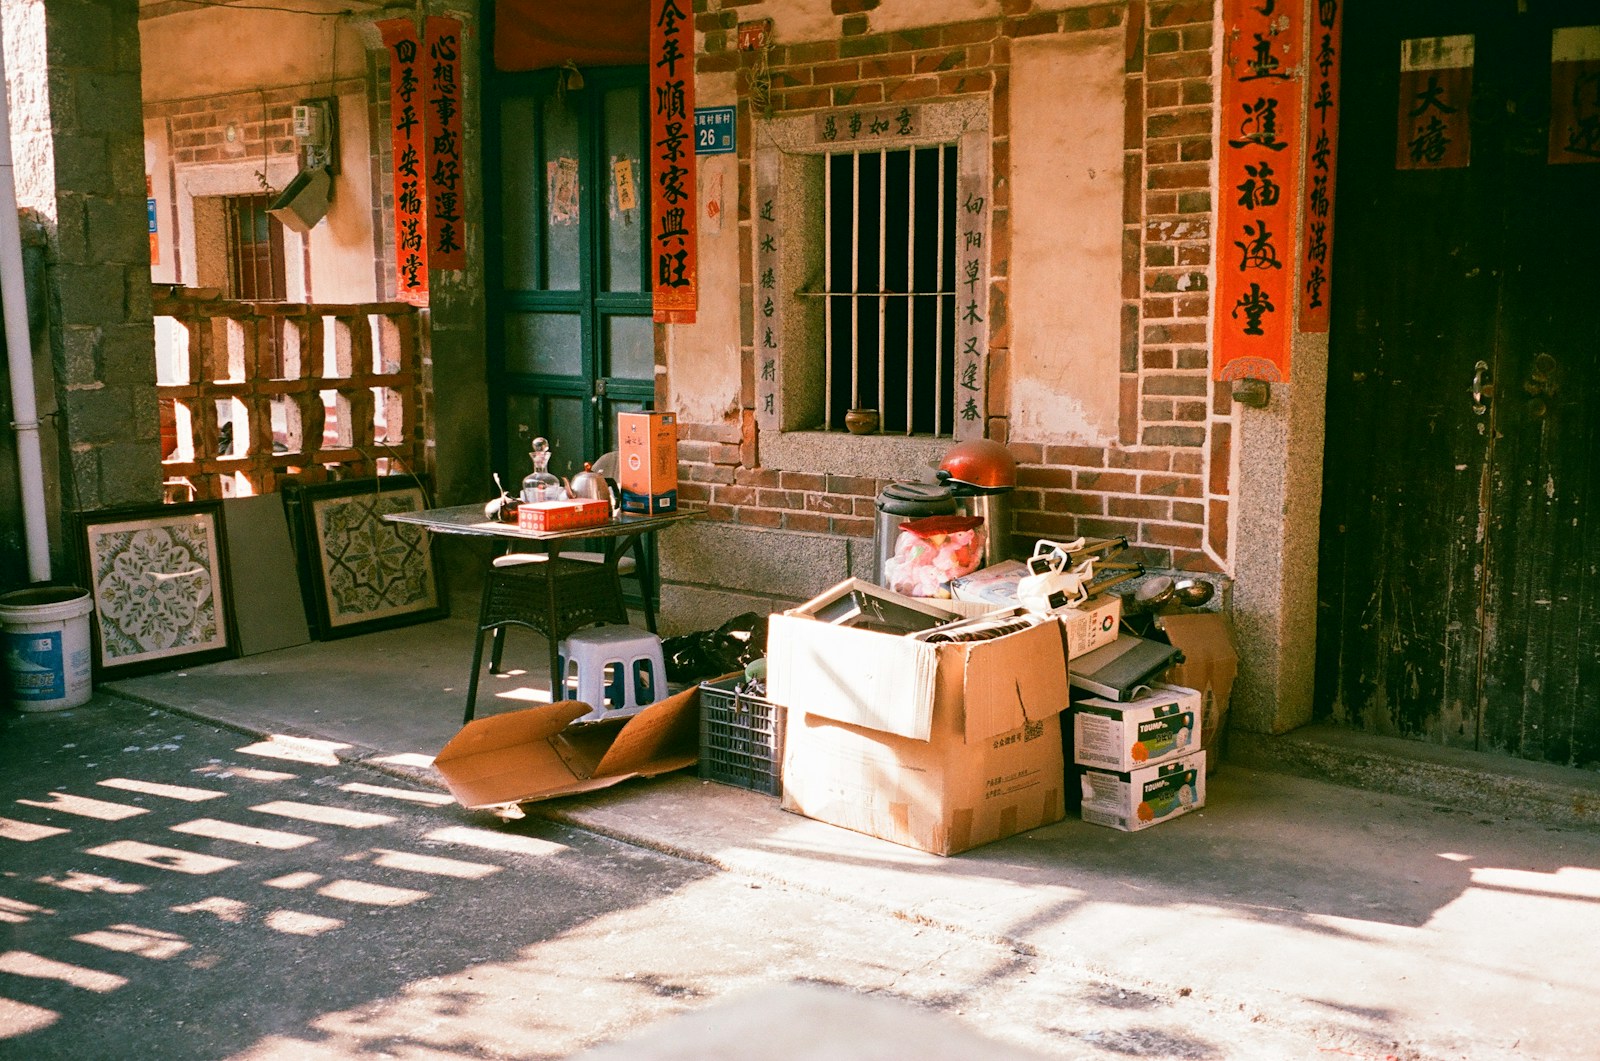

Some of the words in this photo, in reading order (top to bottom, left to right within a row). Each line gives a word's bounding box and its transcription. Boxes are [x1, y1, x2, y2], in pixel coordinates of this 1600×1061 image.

[700, 129, 715, 146] 26
[960, 192, 984, 421] 向阳草木又逢春
